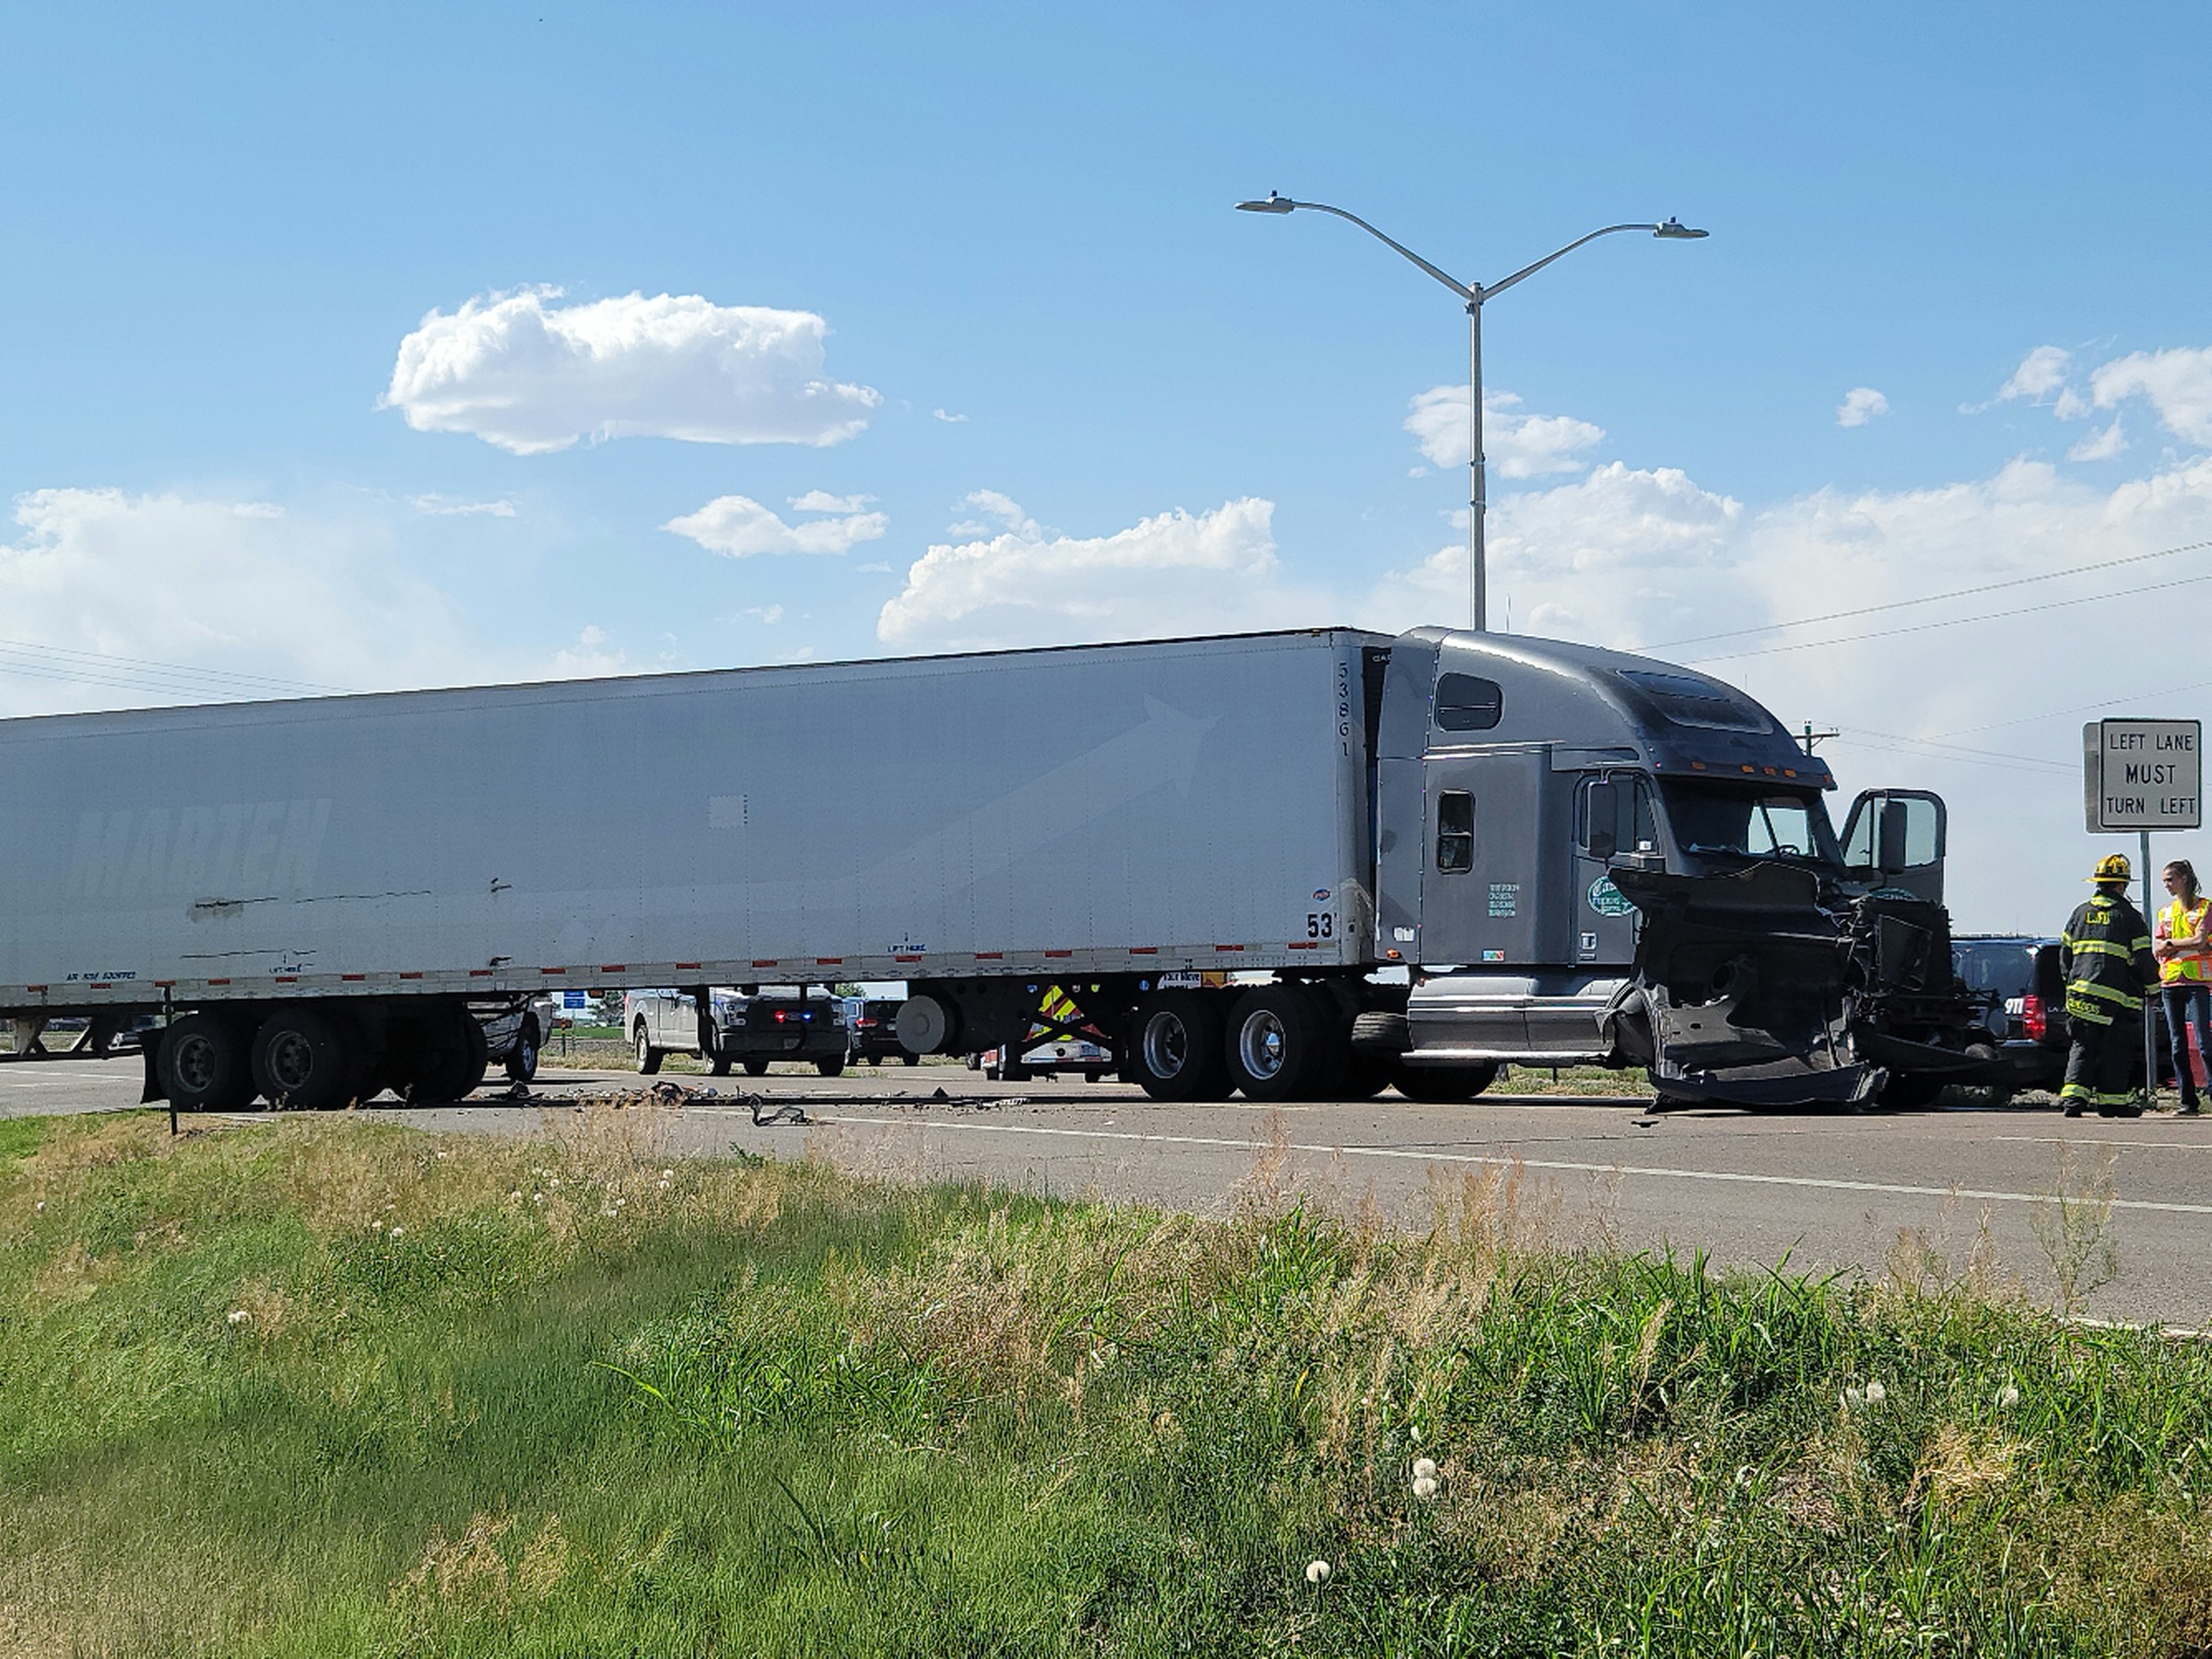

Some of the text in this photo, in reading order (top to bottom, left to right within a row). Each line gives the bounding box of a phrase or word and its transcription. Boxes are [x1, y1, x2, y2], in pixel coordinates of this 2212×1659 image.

[1339, 663, 1348, 756] 53861
[2111, 734, 2193, 750] LEFT LANE
[2126, 764, 2176, 784] MUST
[2107, 797, 2195, 814] TURN LEFT
[2005, 998, 2024, 1014] 911
